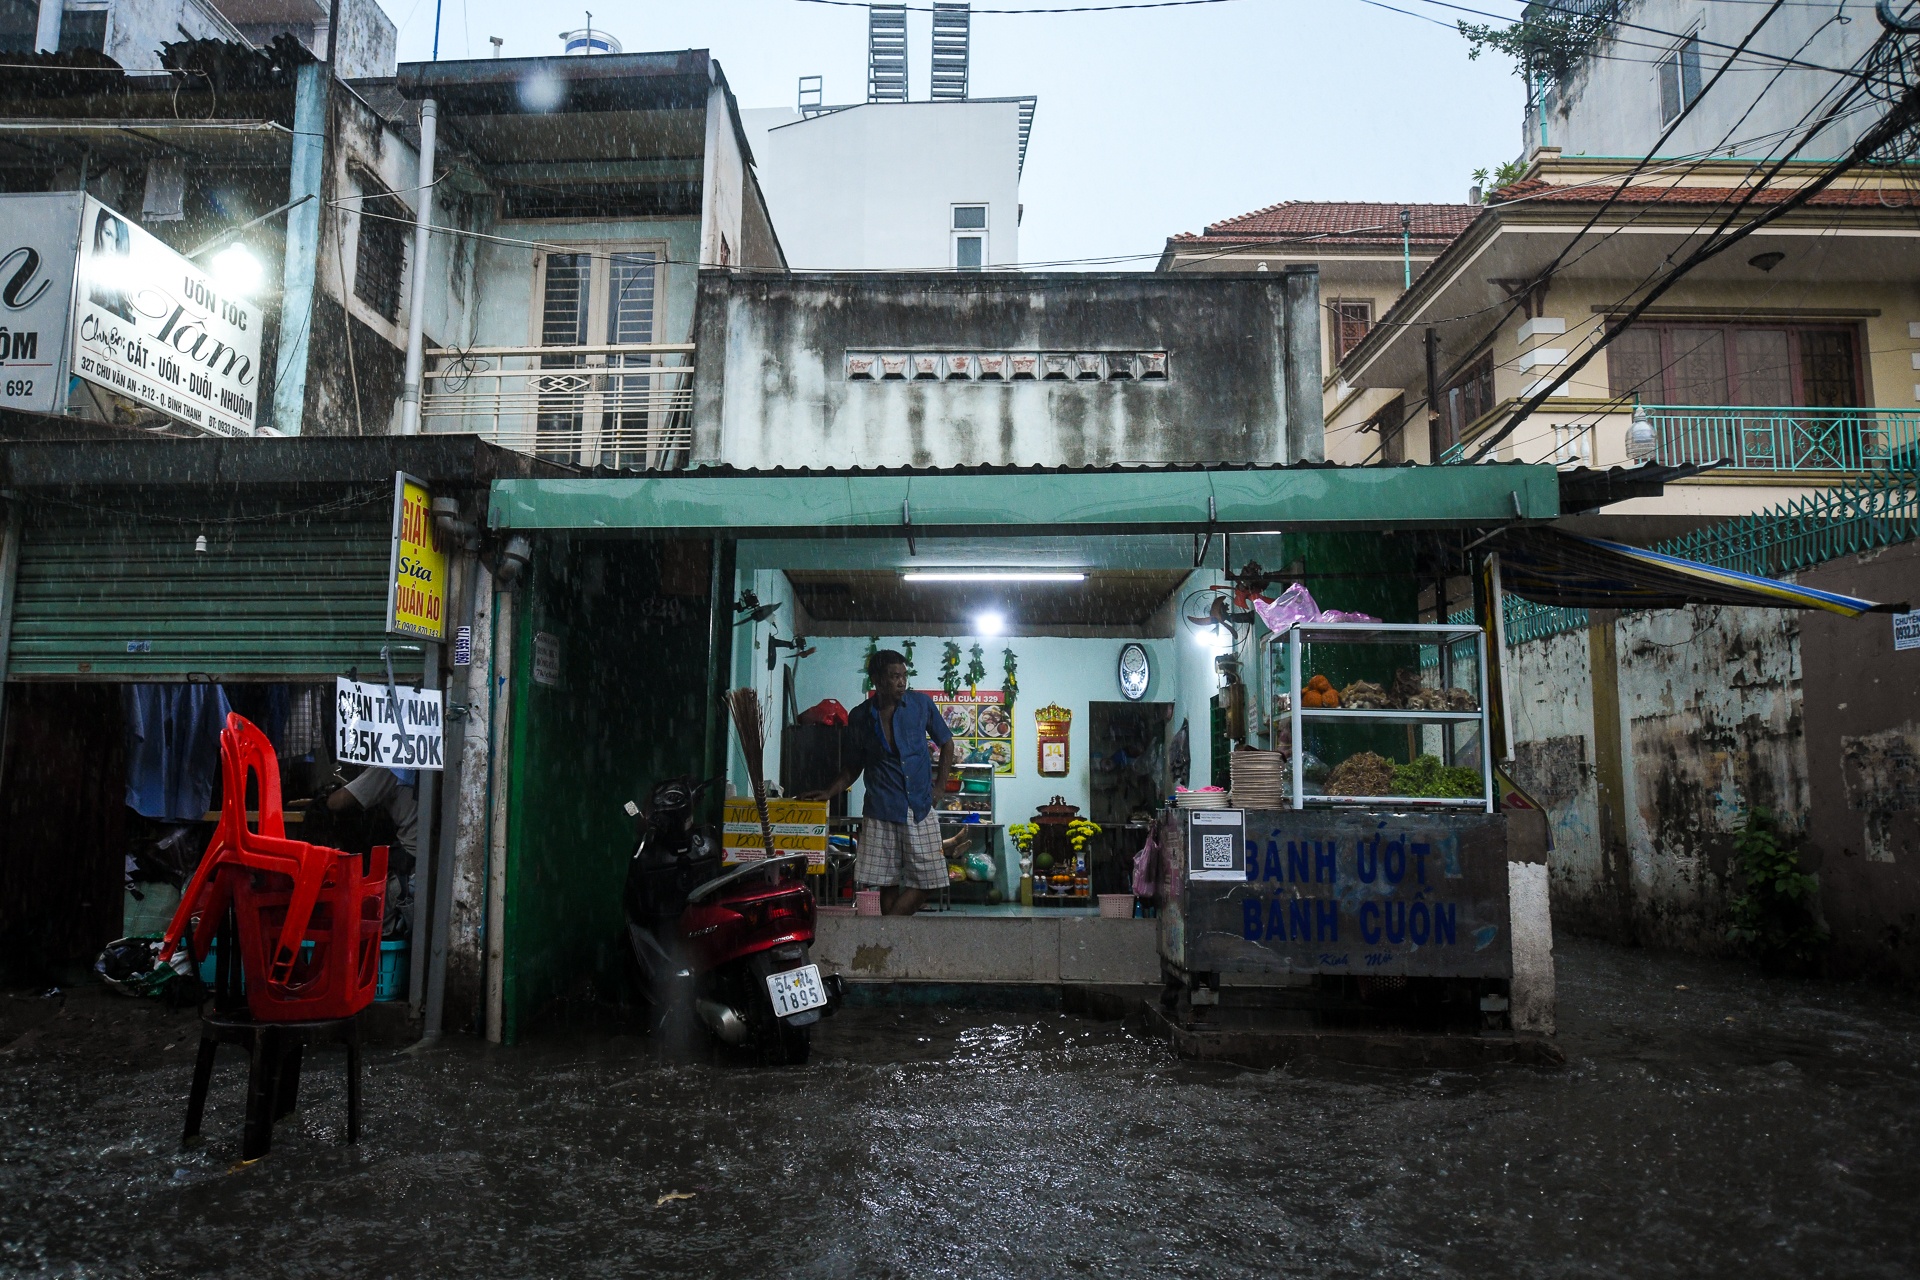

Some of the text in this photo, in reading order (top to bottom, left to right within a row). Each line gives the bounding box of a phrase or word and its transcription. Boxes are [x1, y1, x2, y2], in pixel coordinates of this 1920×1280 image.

[221, 297, 247, 331] TÓC
[128, 284, 254, 386] Tâm
[6, 379, 33, 397] 692
[81, 356, 95, 373] 327
[96, 362, 111, 381] CHU
[112, 369, 126, 388] VĂN
[127, 377, 137, 393] AN
[142, 384, 155, 401] P.12
[167, 395, 182, 414] BÌNH
[183, 403, 202, 422] THẠNH
[217, 419, 231, 435] 0933
[127, 337, 149, 369] CẮT
[158, 354, 180, 385] UỐN
[220, 387, 253, 421] NHUỘM
[401, 495, 430, 553] GIẶT
[398, 556, 432, 582] Sửa
[426, 589, 440, 622] ÁO
[1895, 615, 1920, 626] CHUYÊ
[375, 689, 405, 724] TÂY
[408, 699, 440, 727] NAM
[983, 695, 999, 703] 329
[1046, 744, 1062, 757] 14
[730, 802, 762, 824] NƯỚ
[1245, 828, 1337, 884] BÁNH
[1357, 820, 1431, 885] ƯỚT
[1242, 885, 1457, 946] BÁNH CUỐN
[779, 987, 819, 1013] 1895
